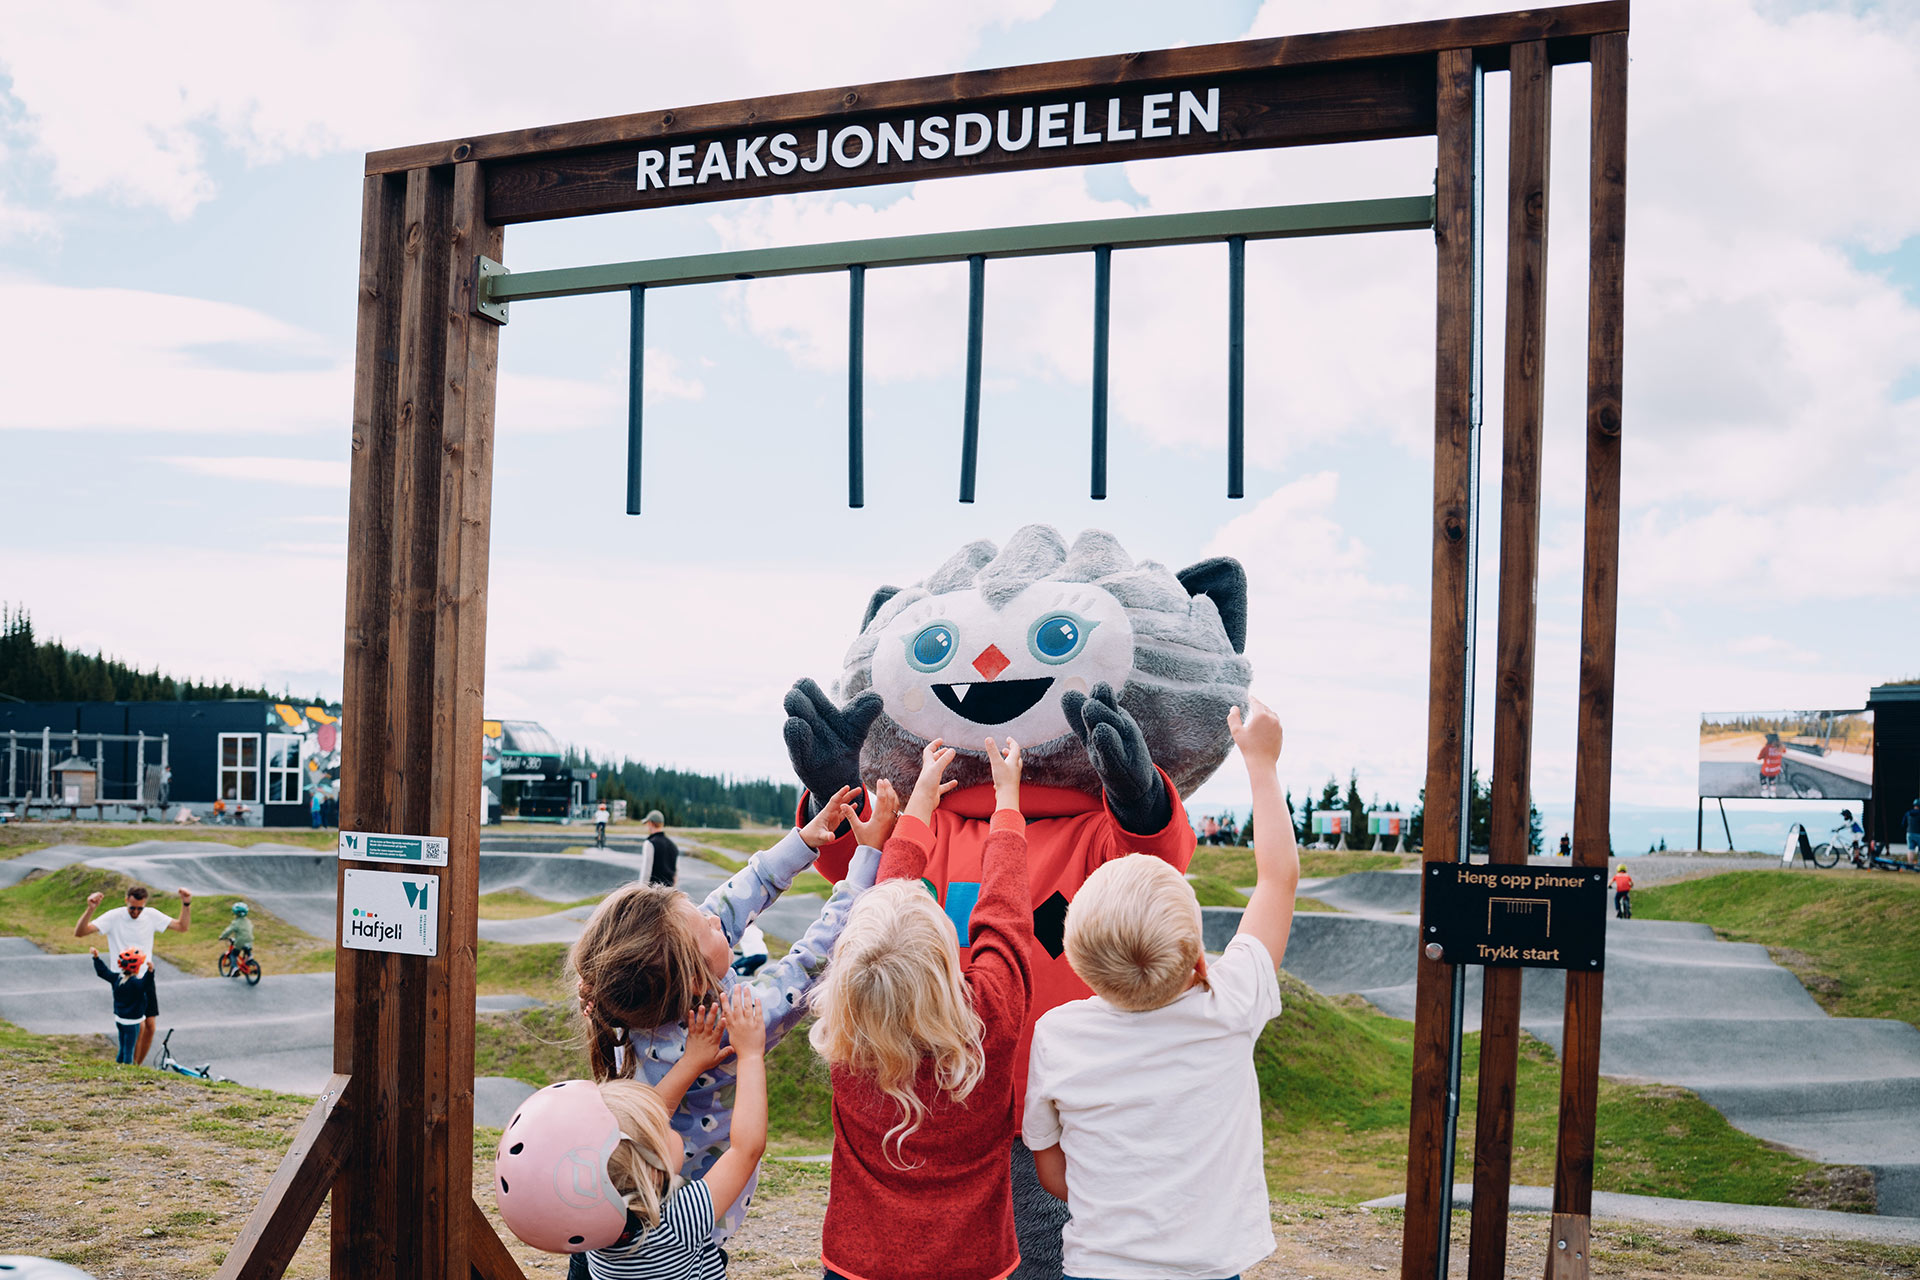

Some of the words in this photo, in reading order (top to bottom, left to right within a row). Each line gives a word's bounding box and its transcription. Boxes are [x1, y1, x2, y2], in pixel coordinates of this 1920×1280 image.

[636, 87, 1220, 191] REAKSJONSDUELLEN
[1457, 870, 1497, 888] Heng
[1501, 874, 1532, 889] opp
[1535, 873, 1585, 890] pinner
[352, 920, 402, 942] Hafjell
[1476, 944, 1519, 961] Trykk
[1522, 947, 1560, 961] start
